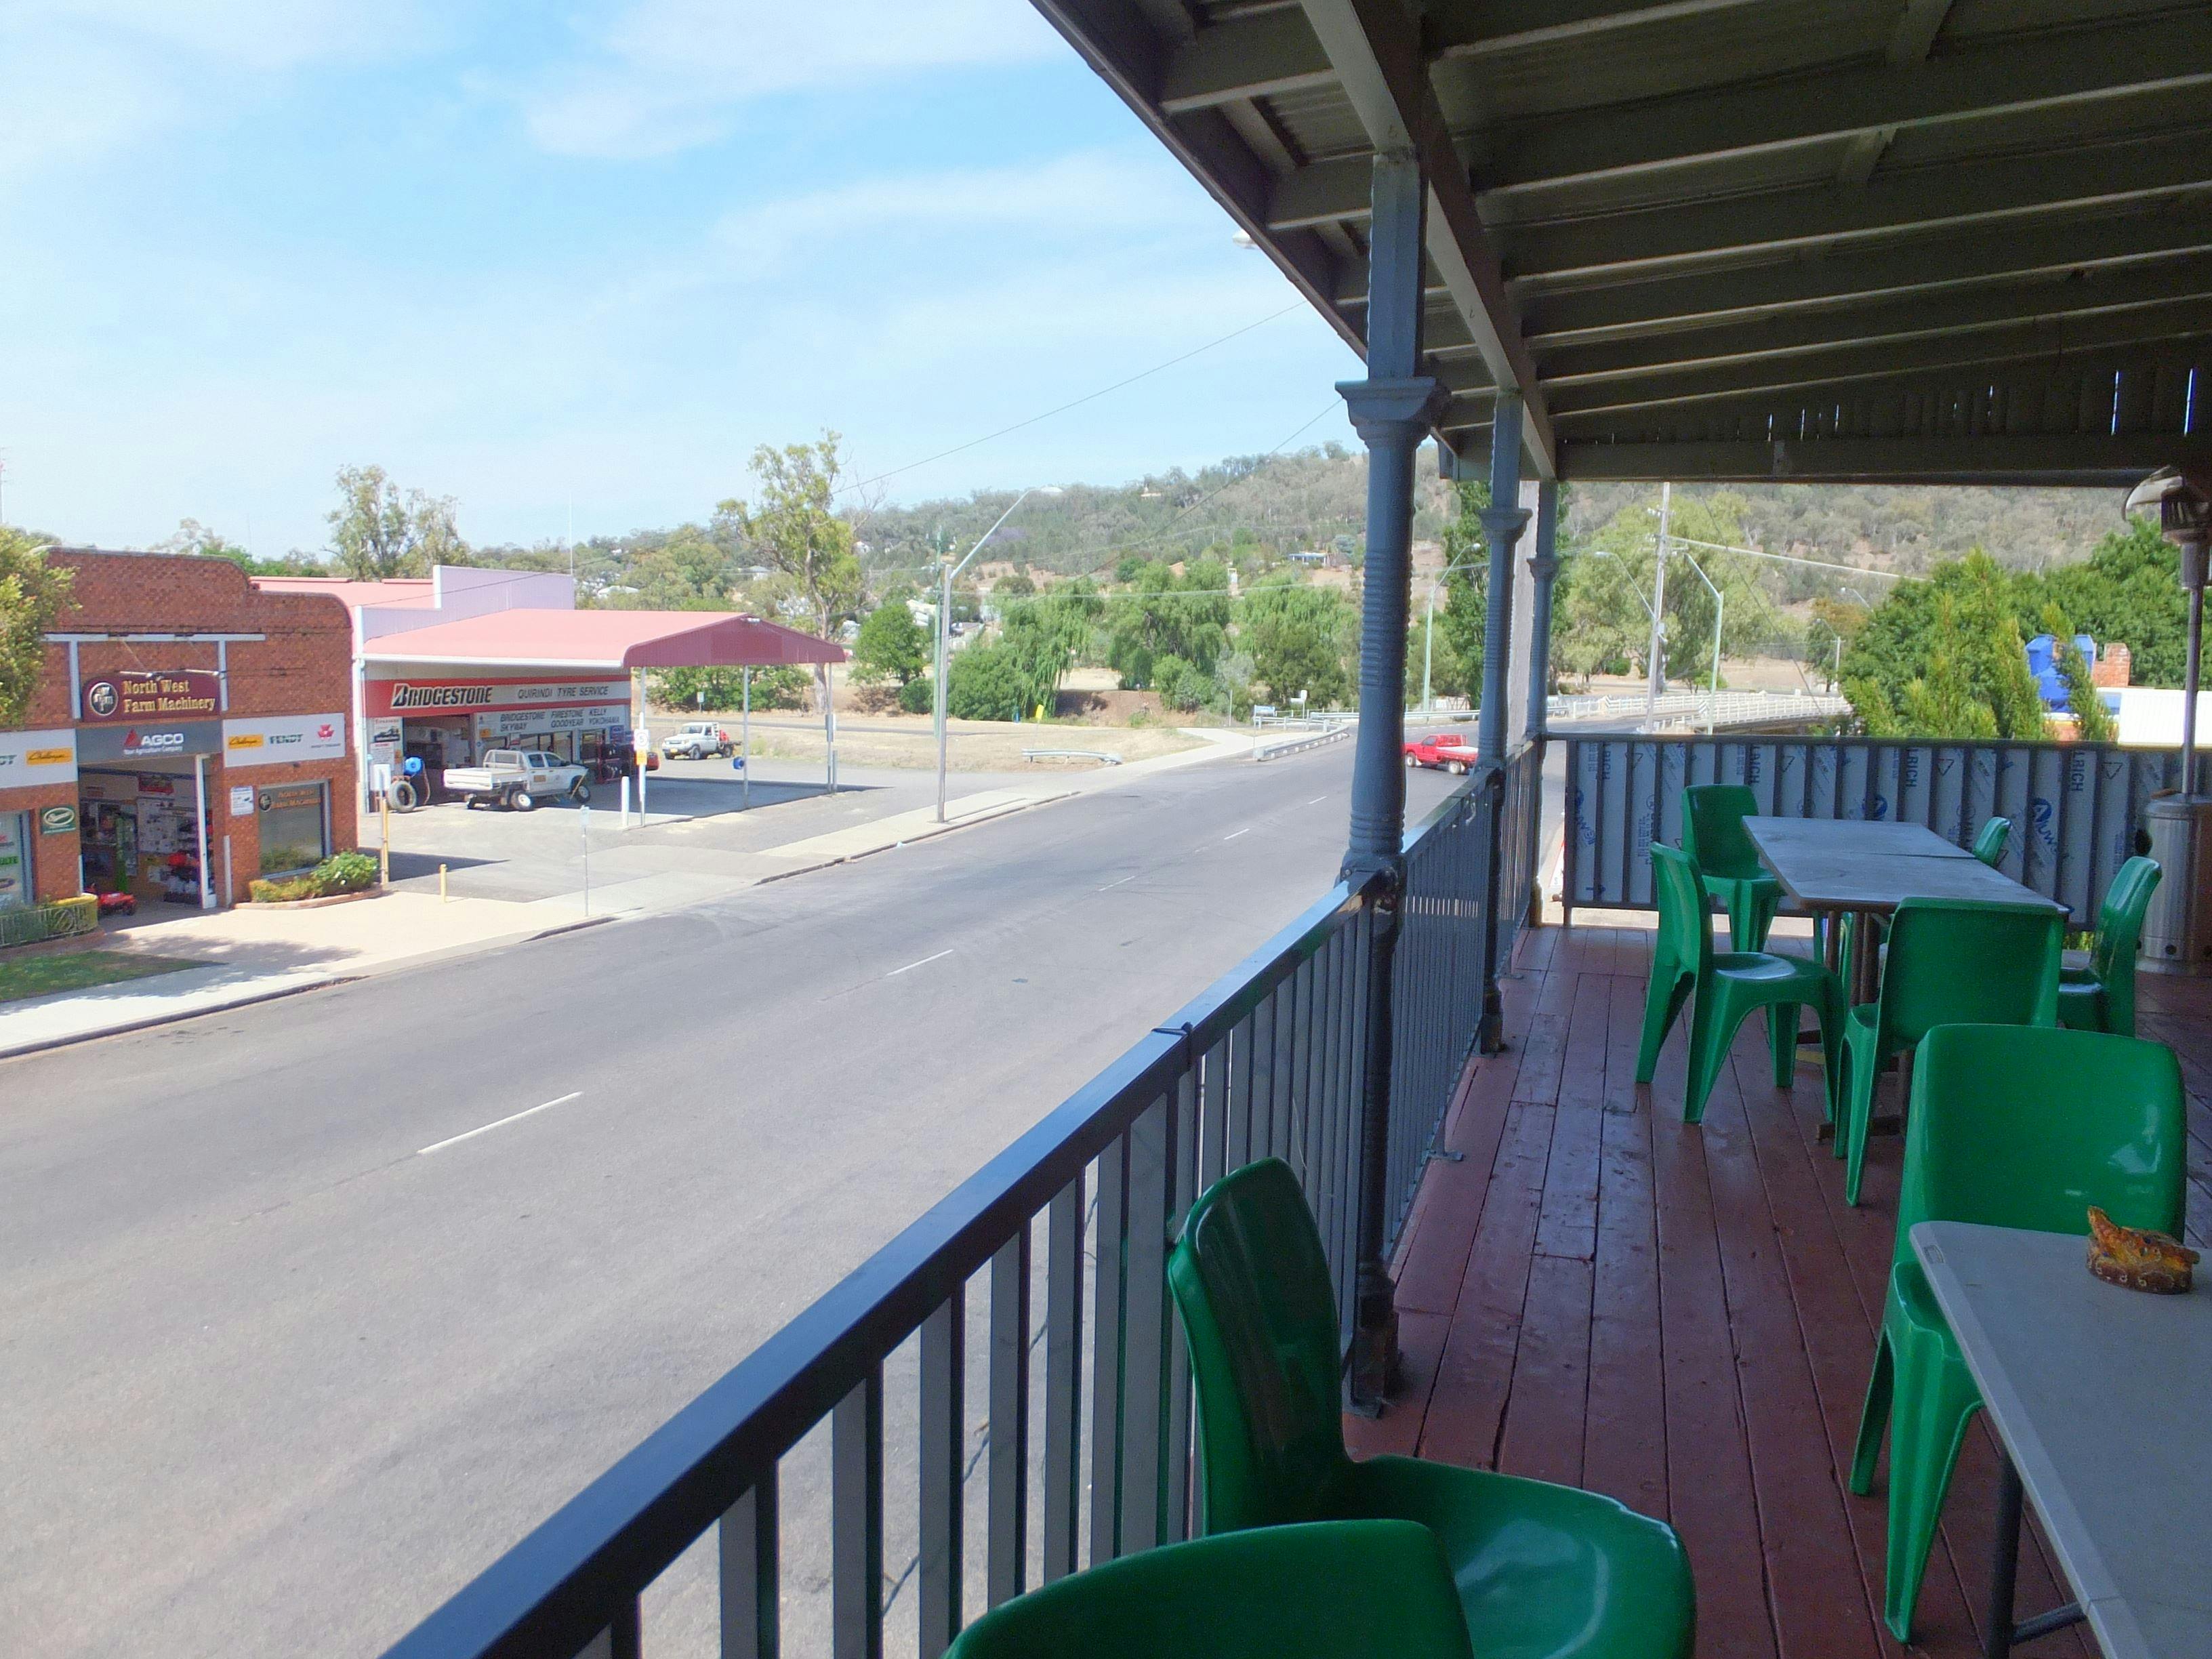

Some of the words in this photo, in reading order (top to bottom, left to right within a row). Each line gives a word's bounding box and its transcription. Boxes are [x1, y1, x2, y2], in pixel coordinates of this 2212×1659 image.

[123, 680, 157, 694] North
[160, 680, 190, 693] West
[517, 688, 552, 699] QUIRINDI
[557, 687, 577, 697] TYRE
[579, 686, 609, 696] SERVICE
[124, 699, 156, 712] Farm
[159, 697, 216, 711] Machinery
[500, 711, 546, 722] BRIDGESTONE
[551, 709, 584, 718] FIRESTONE
[589, 708, 608, 716] KELLY
[551, 718, 584, 728] GOODYEAR
[141, 733, 184, 745] AGCO
[269, 734, 304, 744] FENDT
